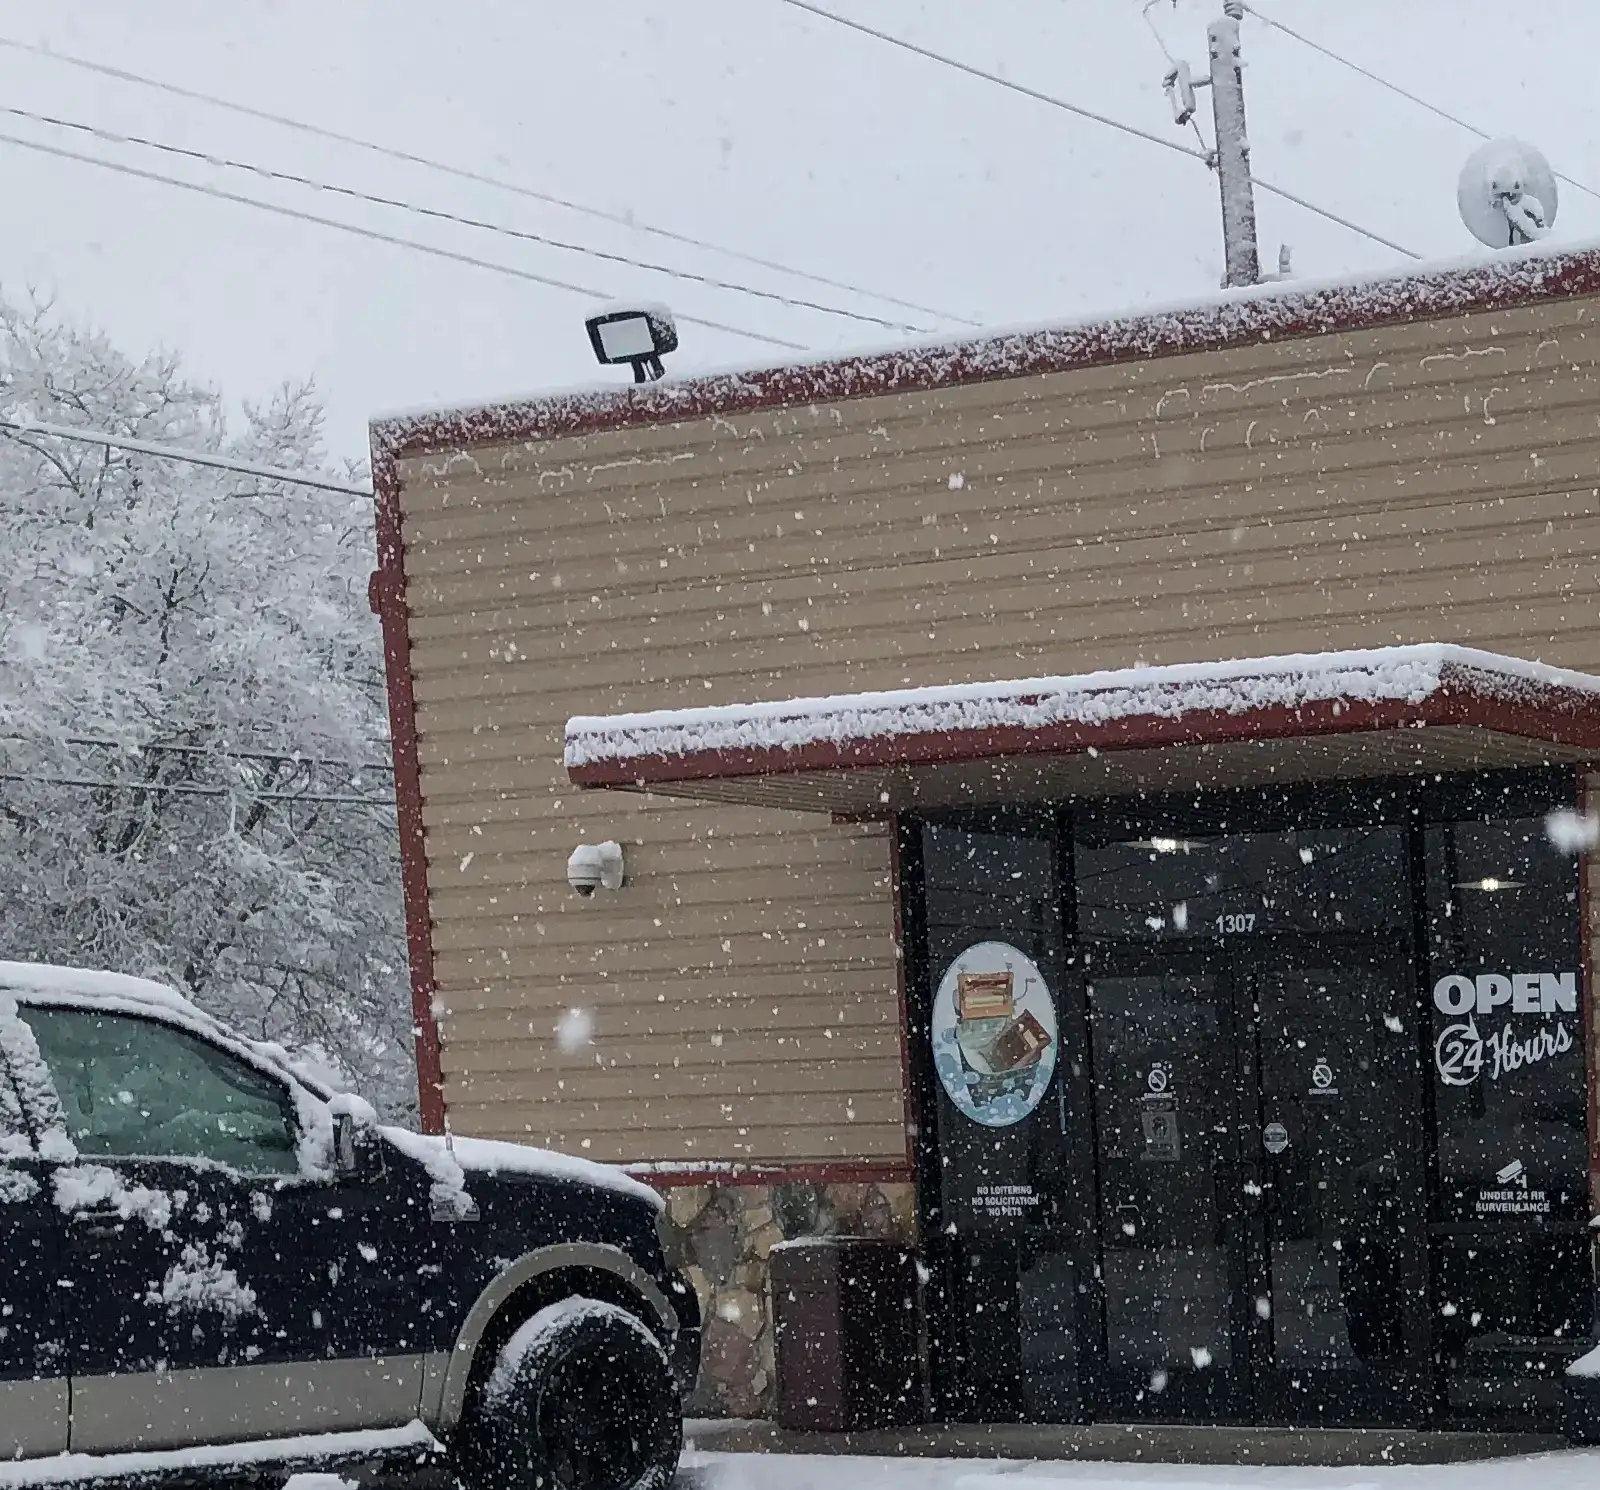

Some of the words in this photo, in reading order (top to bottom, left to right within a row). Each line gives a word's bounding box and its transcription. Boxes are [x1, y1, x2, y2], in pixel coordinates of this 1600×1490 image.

[1215, 913, 1256, 934] 1307
[1433, 972, 1577, 1016] OPEN
[1441, 1039, 1485, 1074] 24
[1485, 1021, 1573, 1081] Hours
[976, 1186, 989, 1195] NO
[990, 1185, 1033, 1195] LOITERING
[1480, 1191, 1514, 1201] UNDER
[1516, 1191, 1529, 1201] 24
[1530, 1190, 1545, 1201] HR
[971, 1196, 984, 1206] NO
[984, 1196, 1039, 1206] SOLICITATION
[988, 1207, 1001, 1217] NO
[1001, 1206, 1023, 1217] PETS
[1475, 1202, 1551, 1213] SURVEILLANCE
